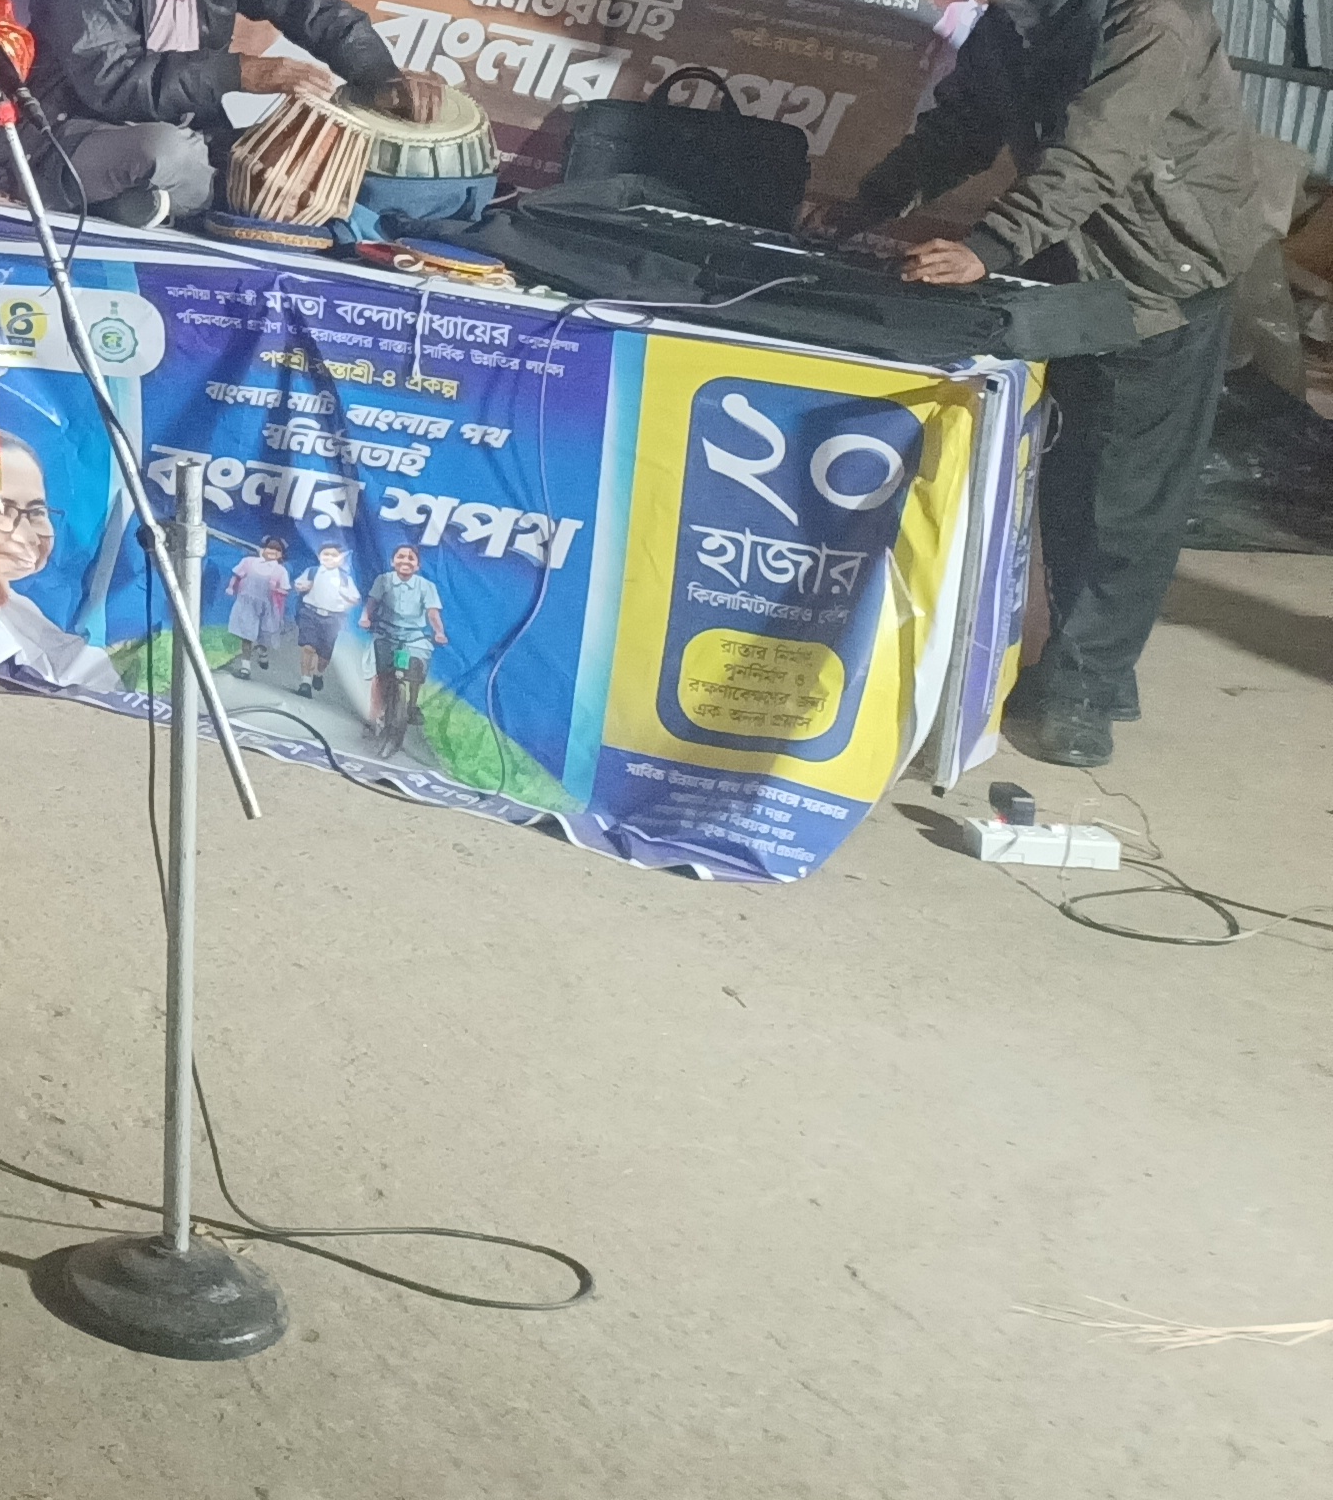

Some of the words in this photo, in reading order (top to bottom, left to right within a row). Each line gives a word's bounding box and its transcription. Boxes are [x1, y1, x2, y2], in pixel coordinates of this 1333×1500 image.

[372, 0, 632, 112] বাংলার
[205, 380, 282, 408] বাংলার
[345, 402, 454, 440] বাংলার
[459, 422, 512, 449] পথ
[701, 393, 905, 527] ২০
[378, 488, 586, 572] শপথ
[689, 521, 869, 597] হাজার
